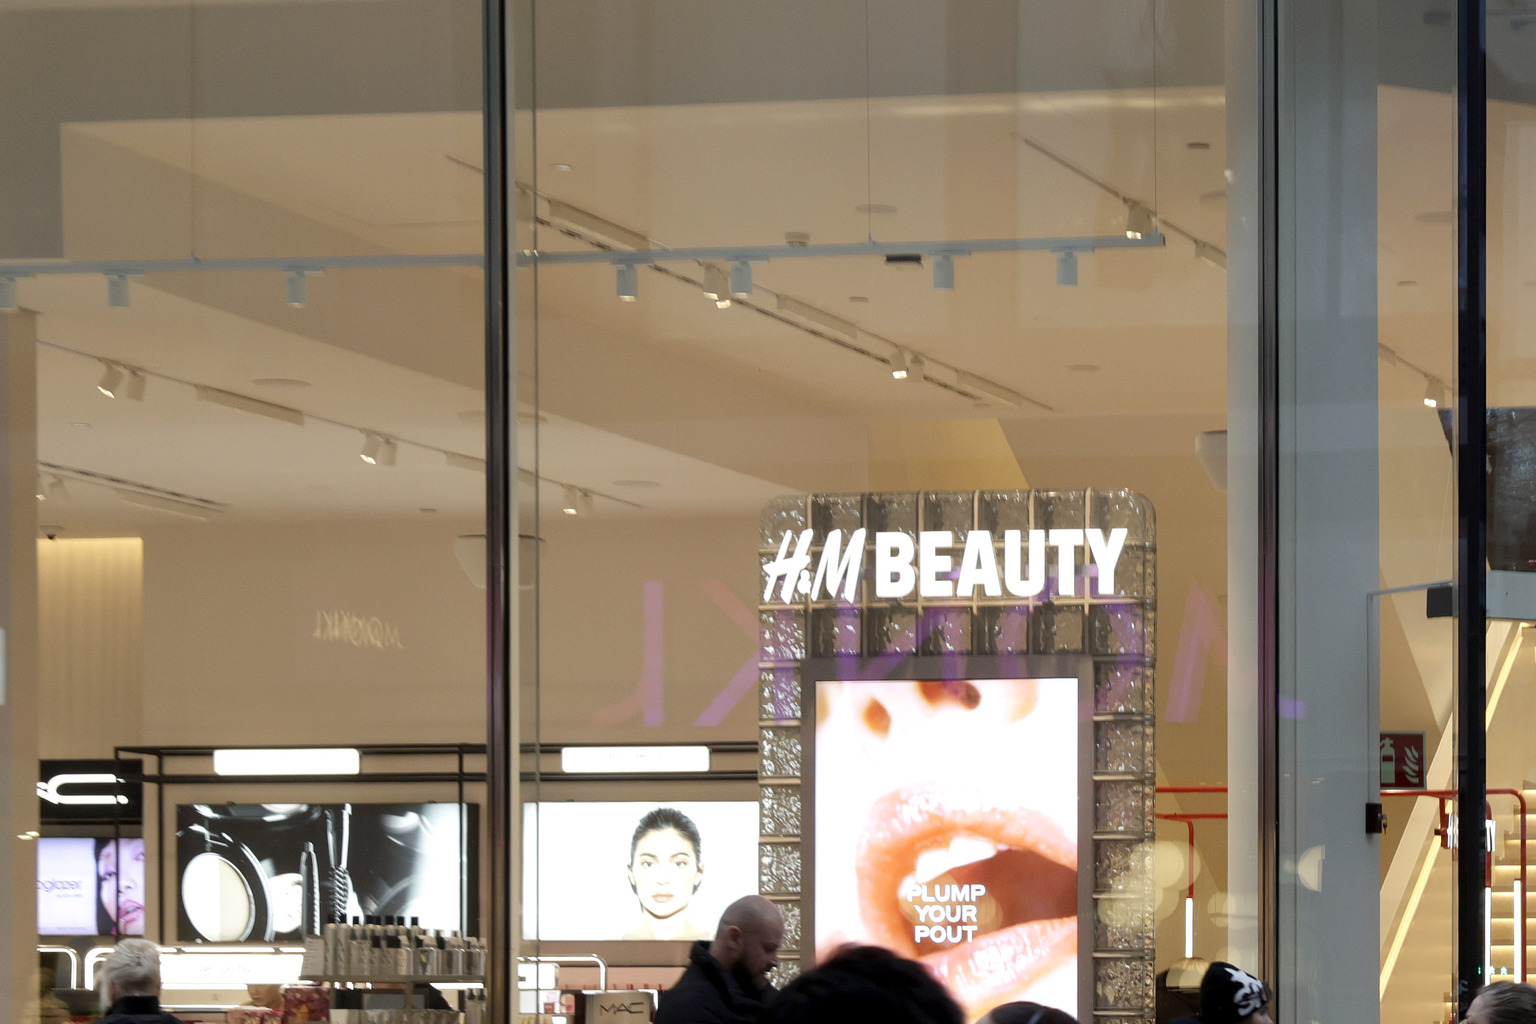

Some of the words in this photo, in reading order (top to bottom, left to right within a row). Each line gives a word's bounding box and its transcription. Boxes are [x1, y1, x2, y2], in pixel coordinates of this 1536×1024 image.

[763, 527, 866, 604] H&M
[875, 527, 1129, 598] BEAUTY
[906, 884, 986, 902] PLUMP
[913, 904, 978, 923] YOUR
[914, 925, 978, 943] POUT
[600, 1002, 643, 1015] MAC
